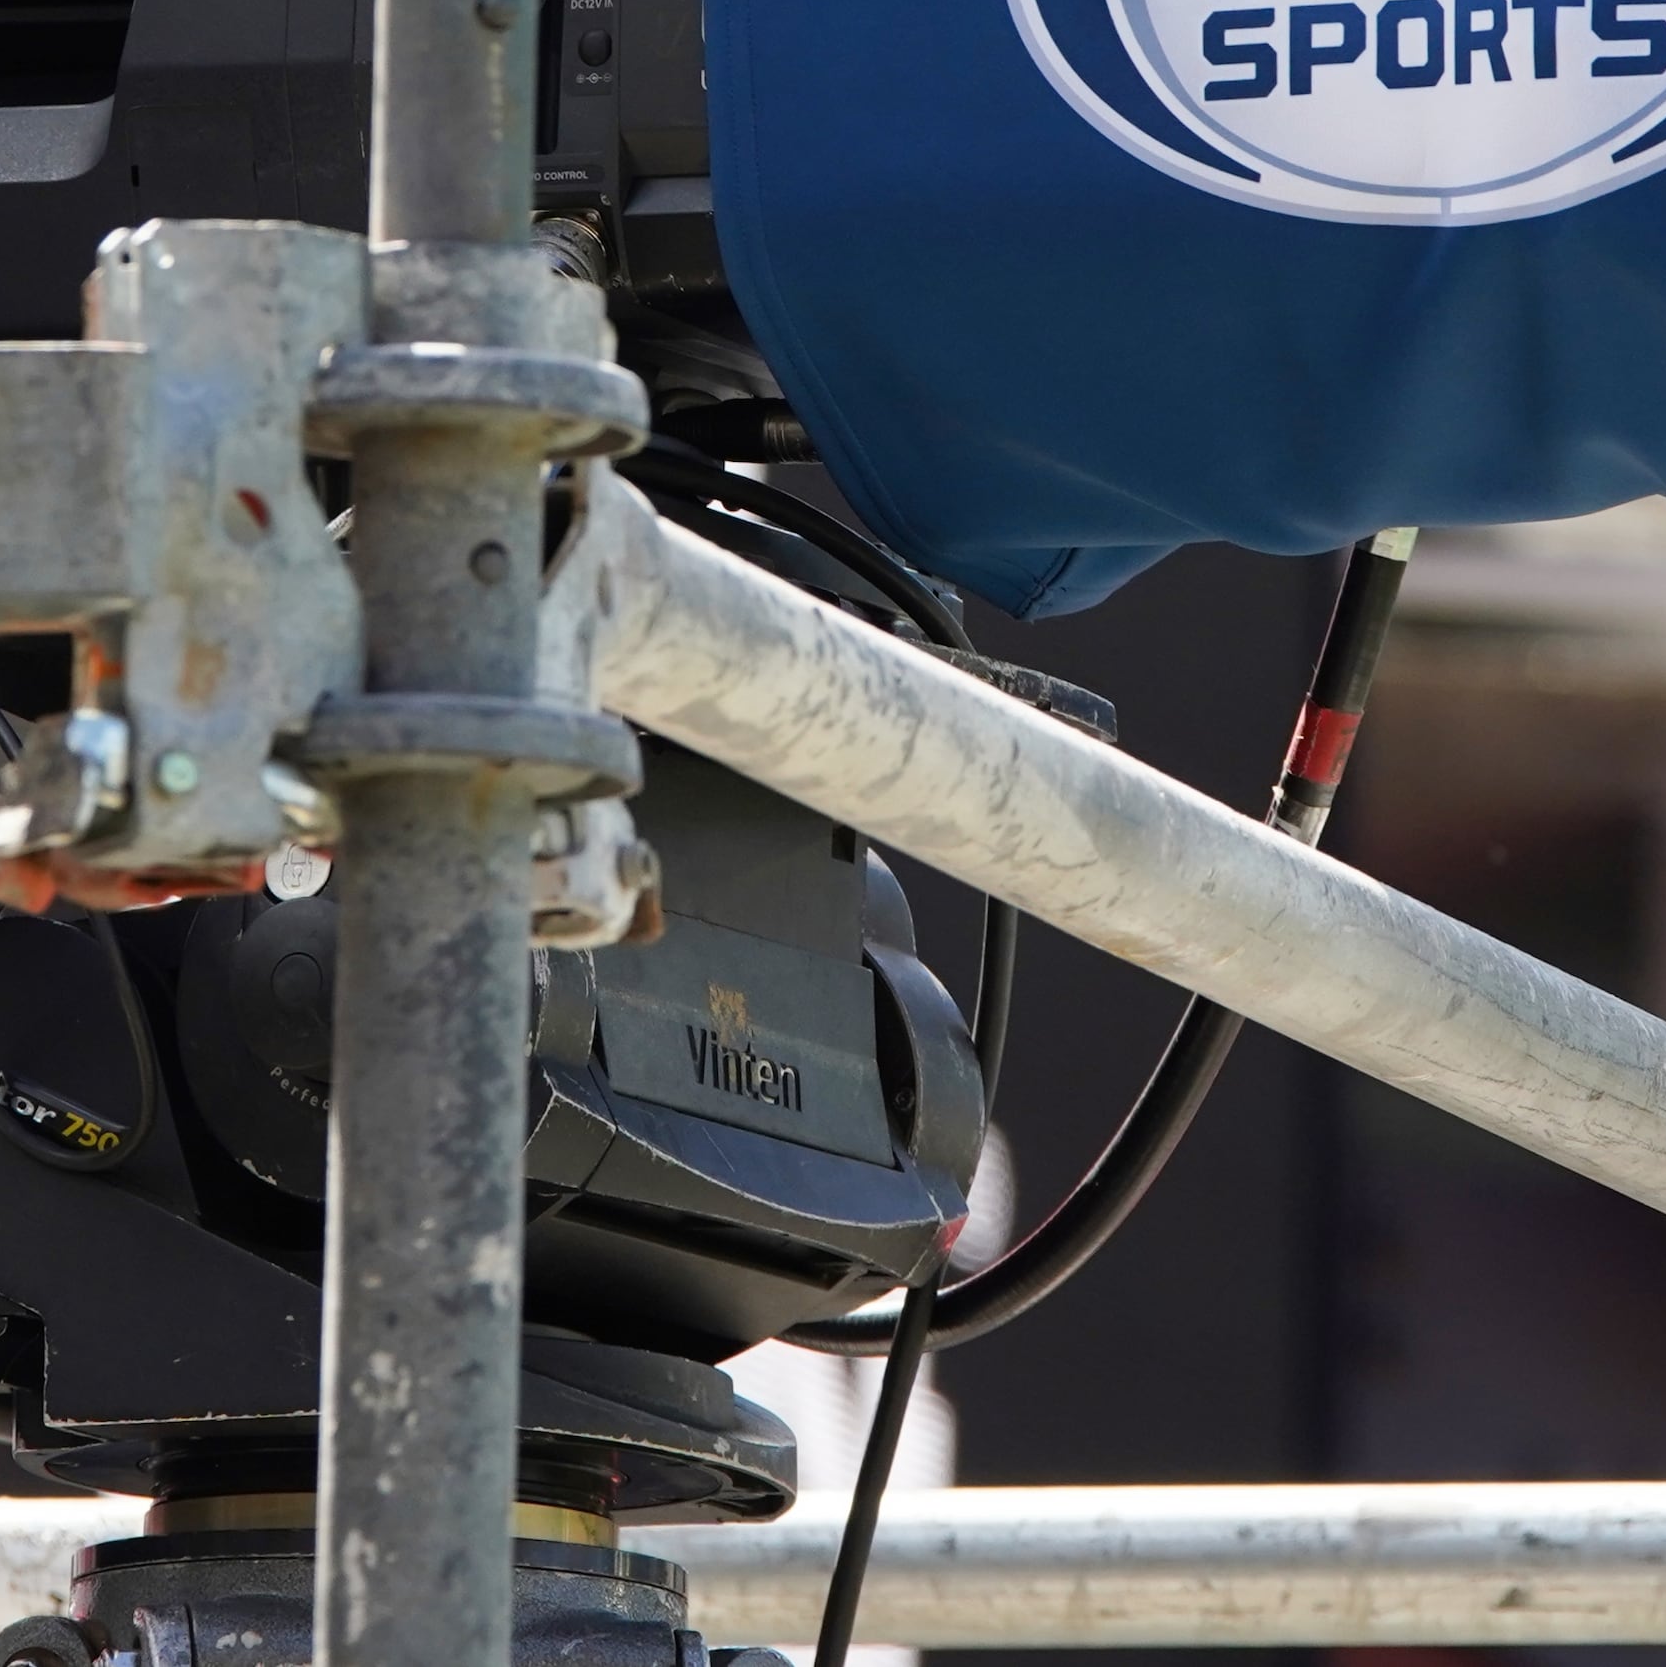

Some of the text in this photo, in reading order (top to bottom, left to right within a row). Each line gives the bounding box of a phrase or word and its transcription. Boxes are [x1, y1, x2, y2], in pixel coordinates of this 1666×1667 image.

[543, 170, 590, 182] CONTROL
[269, 1065, 331, 1110] Perfec
[685, 1023, 803, 1113] Vinten
[60, 1111, 121, 1154] 750
